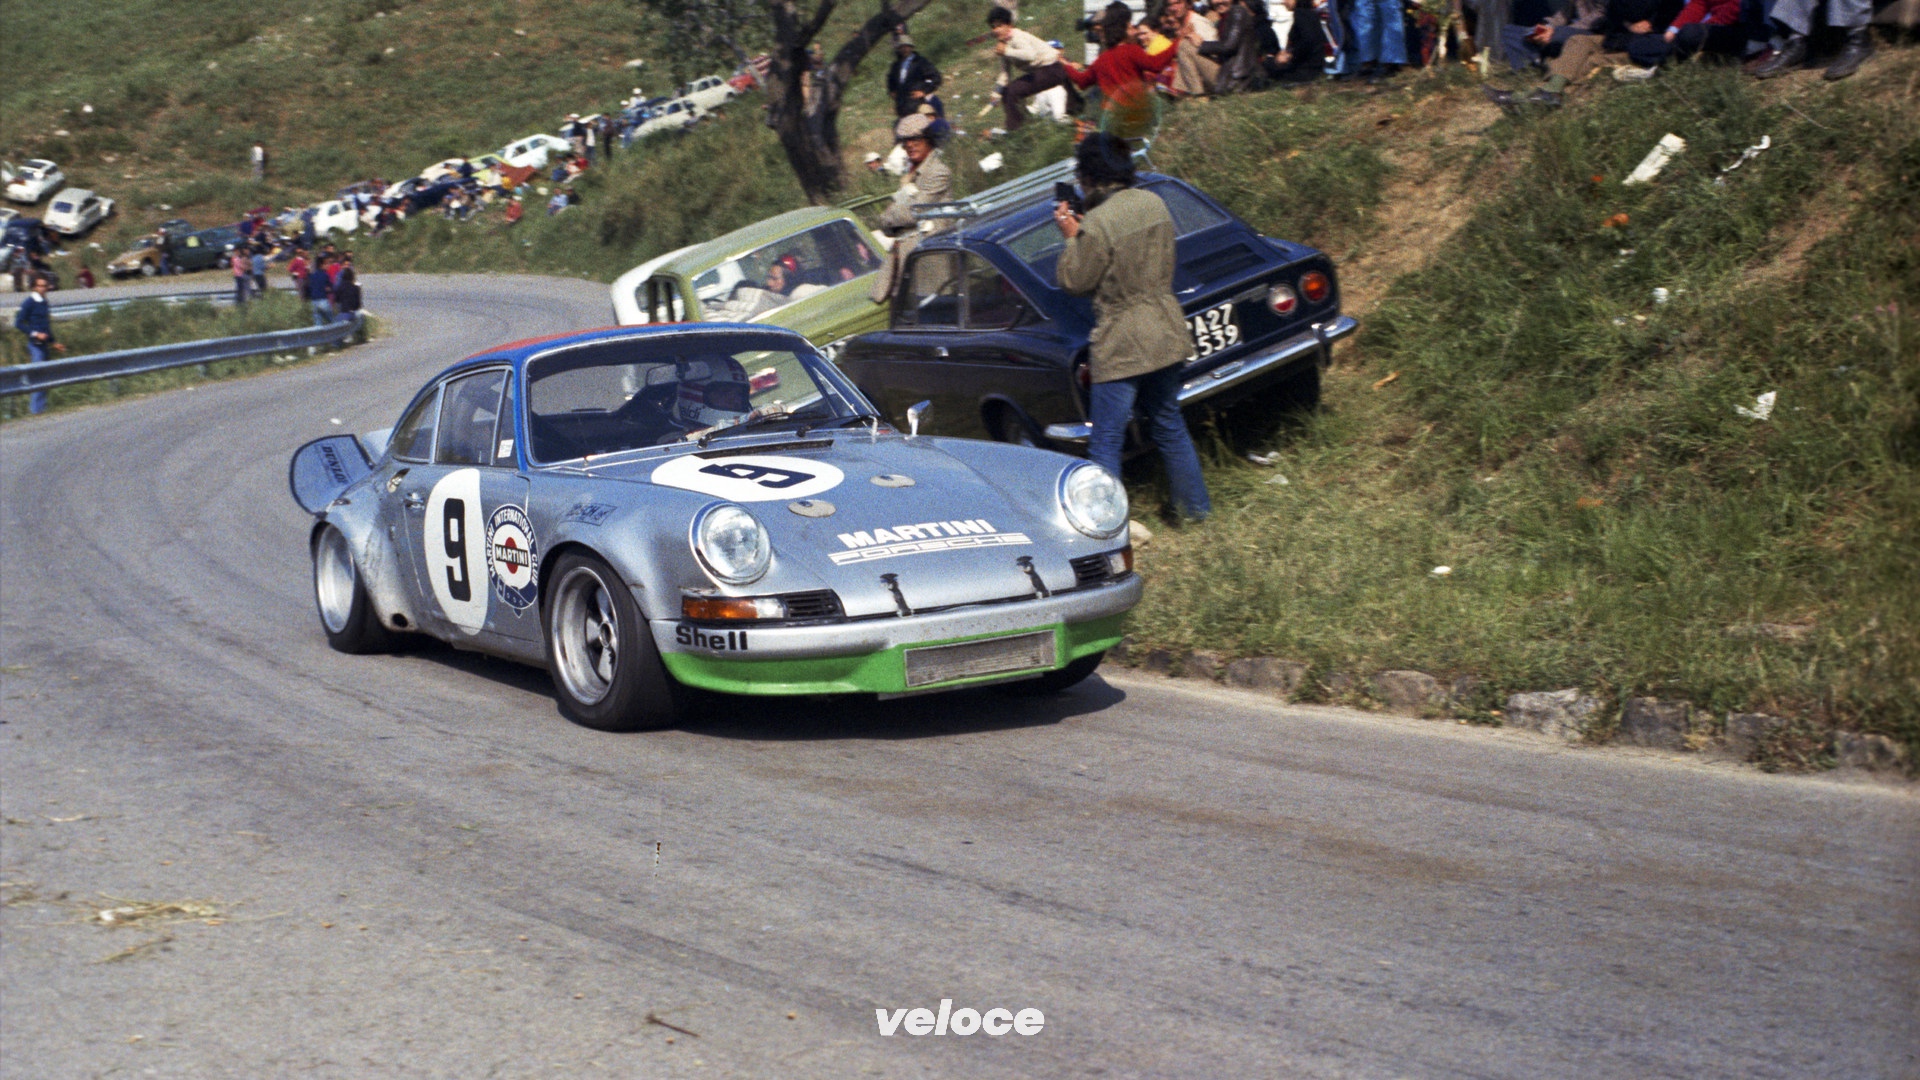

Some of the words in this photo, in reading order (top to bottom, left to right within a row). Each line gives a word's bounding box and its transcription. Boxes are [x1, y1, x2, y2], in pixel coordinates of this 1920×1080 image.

[698, 463, 816, 489] 9
[836, 518, 998, 549] MARTINI
[443, 497, 471, 602] 9
[495, 545, 529, 567] MARTINI
[828, 533, 1033, 566] PORSCHE
[675, 624, 748, 651] Shell
